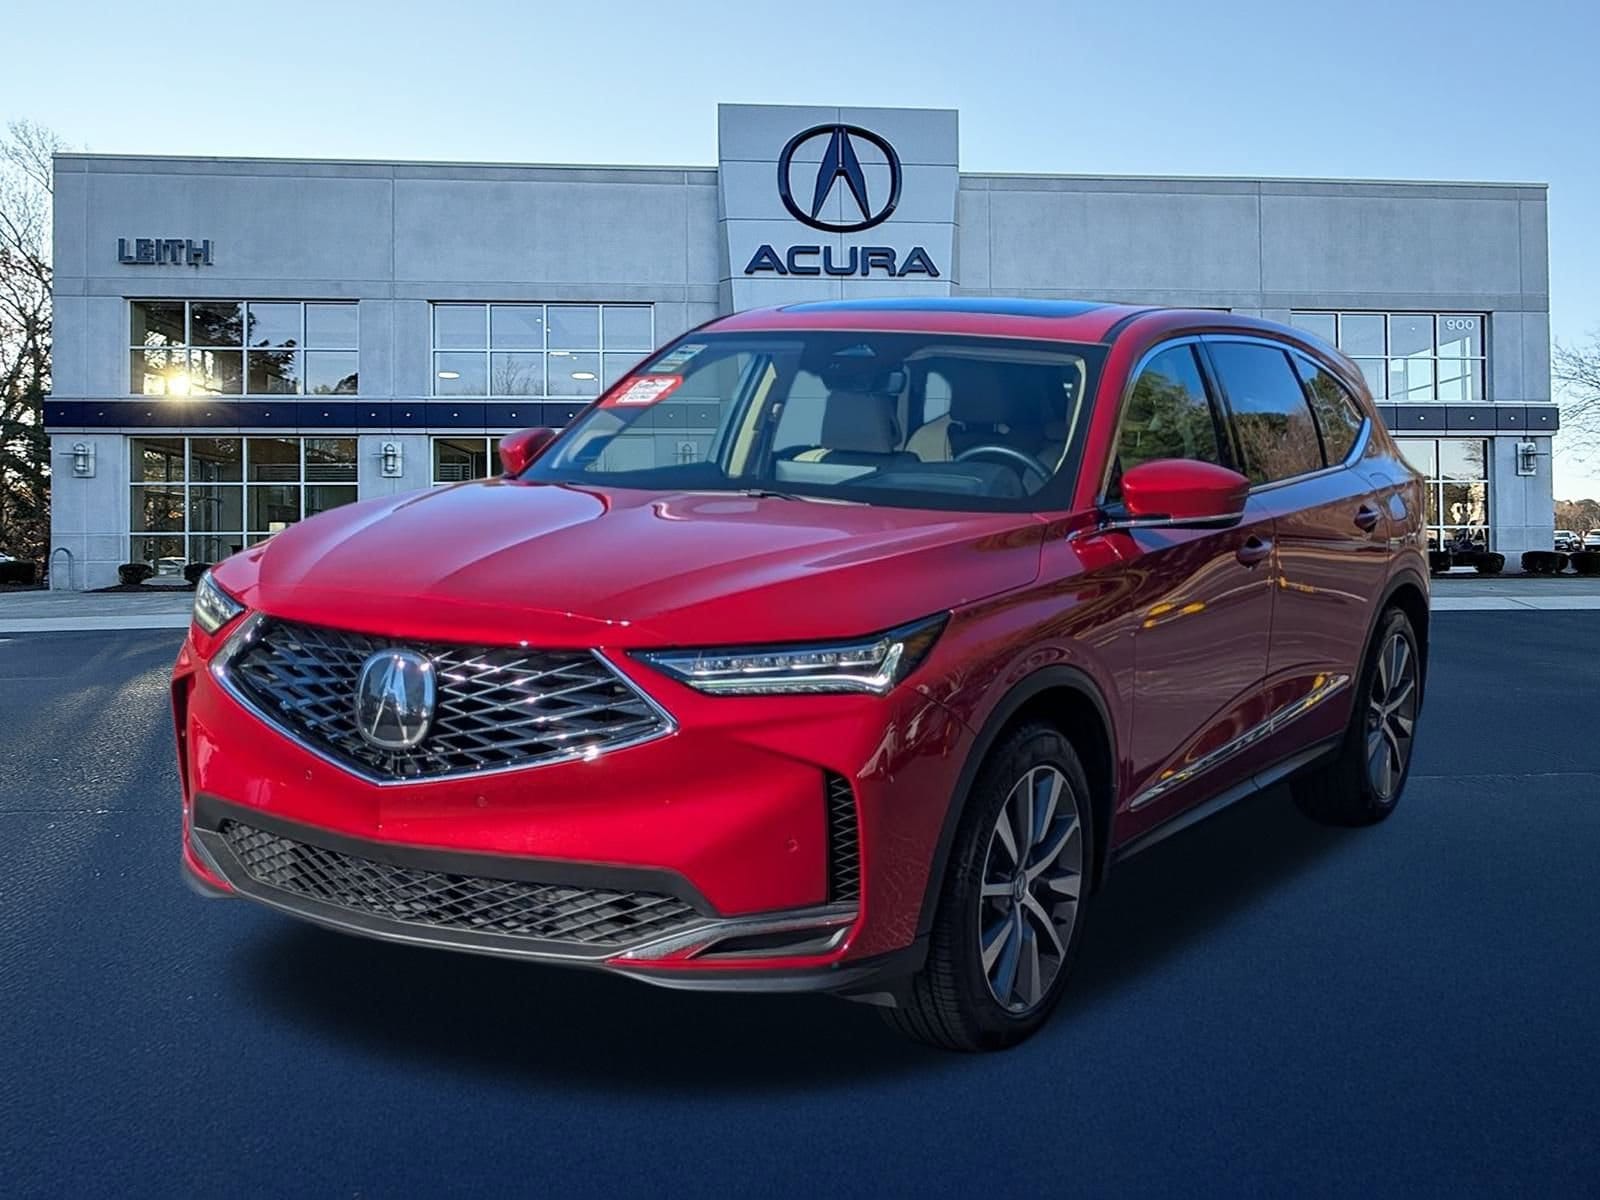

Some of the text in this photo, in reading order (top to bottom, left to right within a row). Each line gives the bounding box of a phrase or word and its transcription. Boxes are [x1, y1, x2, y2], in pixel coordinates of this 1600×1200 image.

[118, 238, 213, 265] LEITH
[744, 244, 940, 277] ACURA
[1446, 319, 1474, 330] 900
